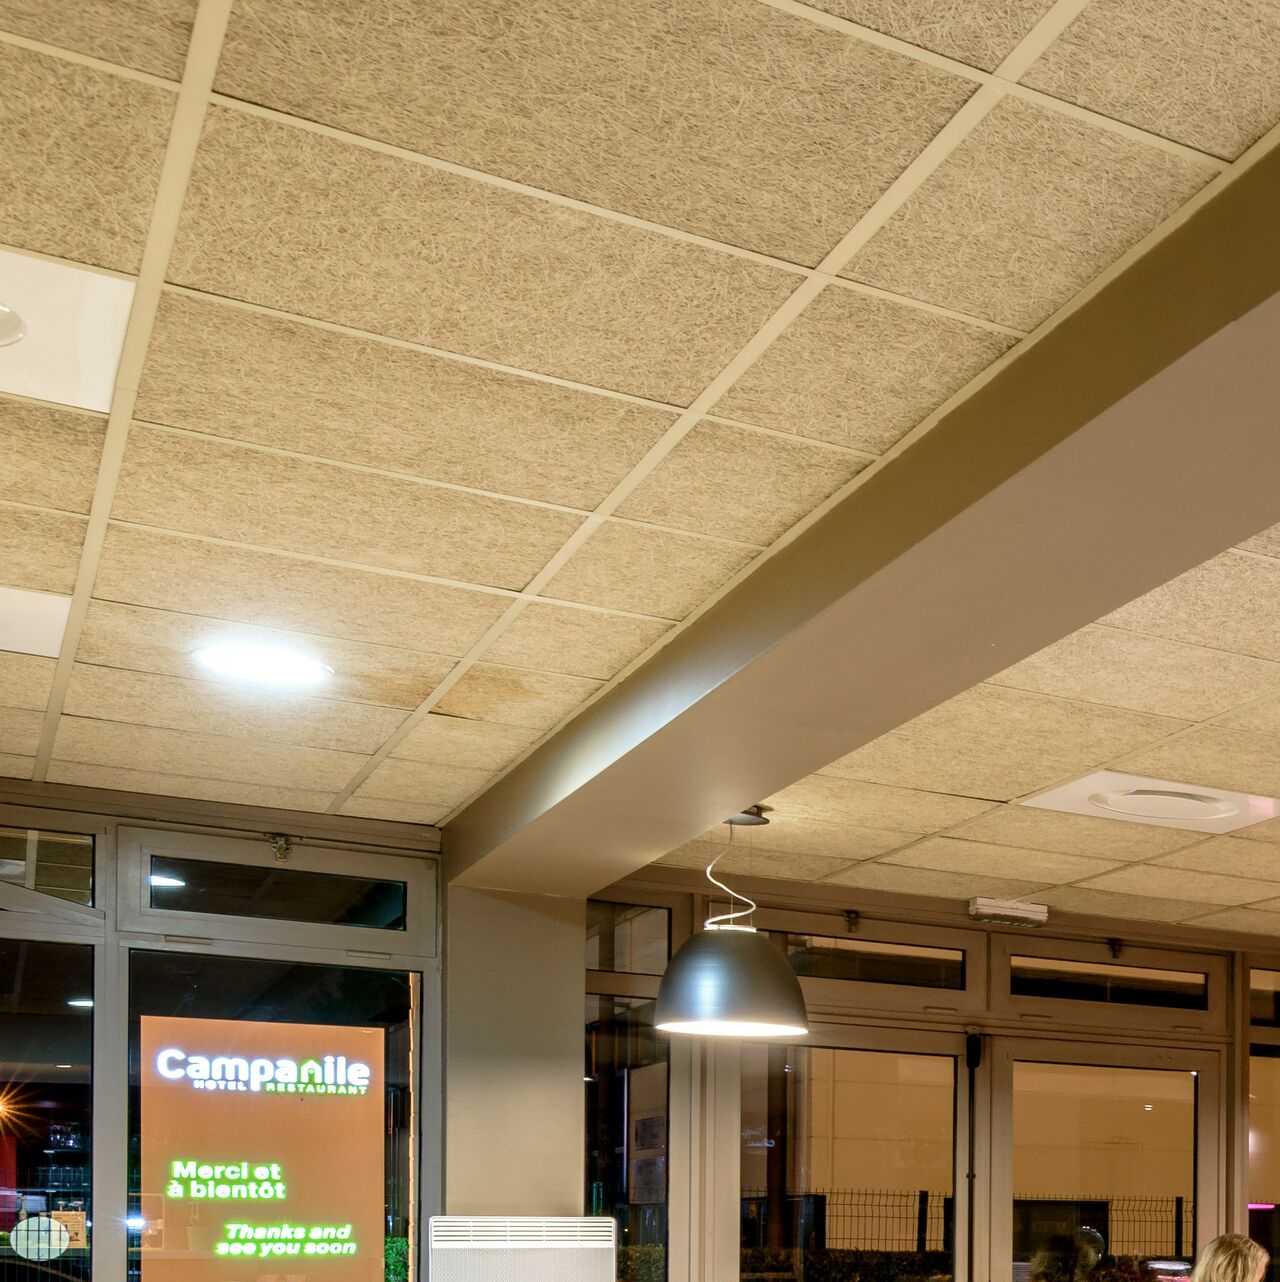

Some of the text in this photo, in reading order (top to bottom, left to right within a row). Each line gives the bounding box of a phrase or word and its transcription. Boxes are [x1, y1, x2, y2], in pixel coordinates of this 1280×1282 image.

[156, 1048, 370, 1092] Campanile
[193, 1079, 368, 1095] HOTEL RESTAURANT
[172, 1160, 281, 1180] Merci et
[167, 1180, 286, 1199] à bientôt
[225, 1223, 352, 1240] Thanks and
[215, 1241, 357, 1258] see you soon
